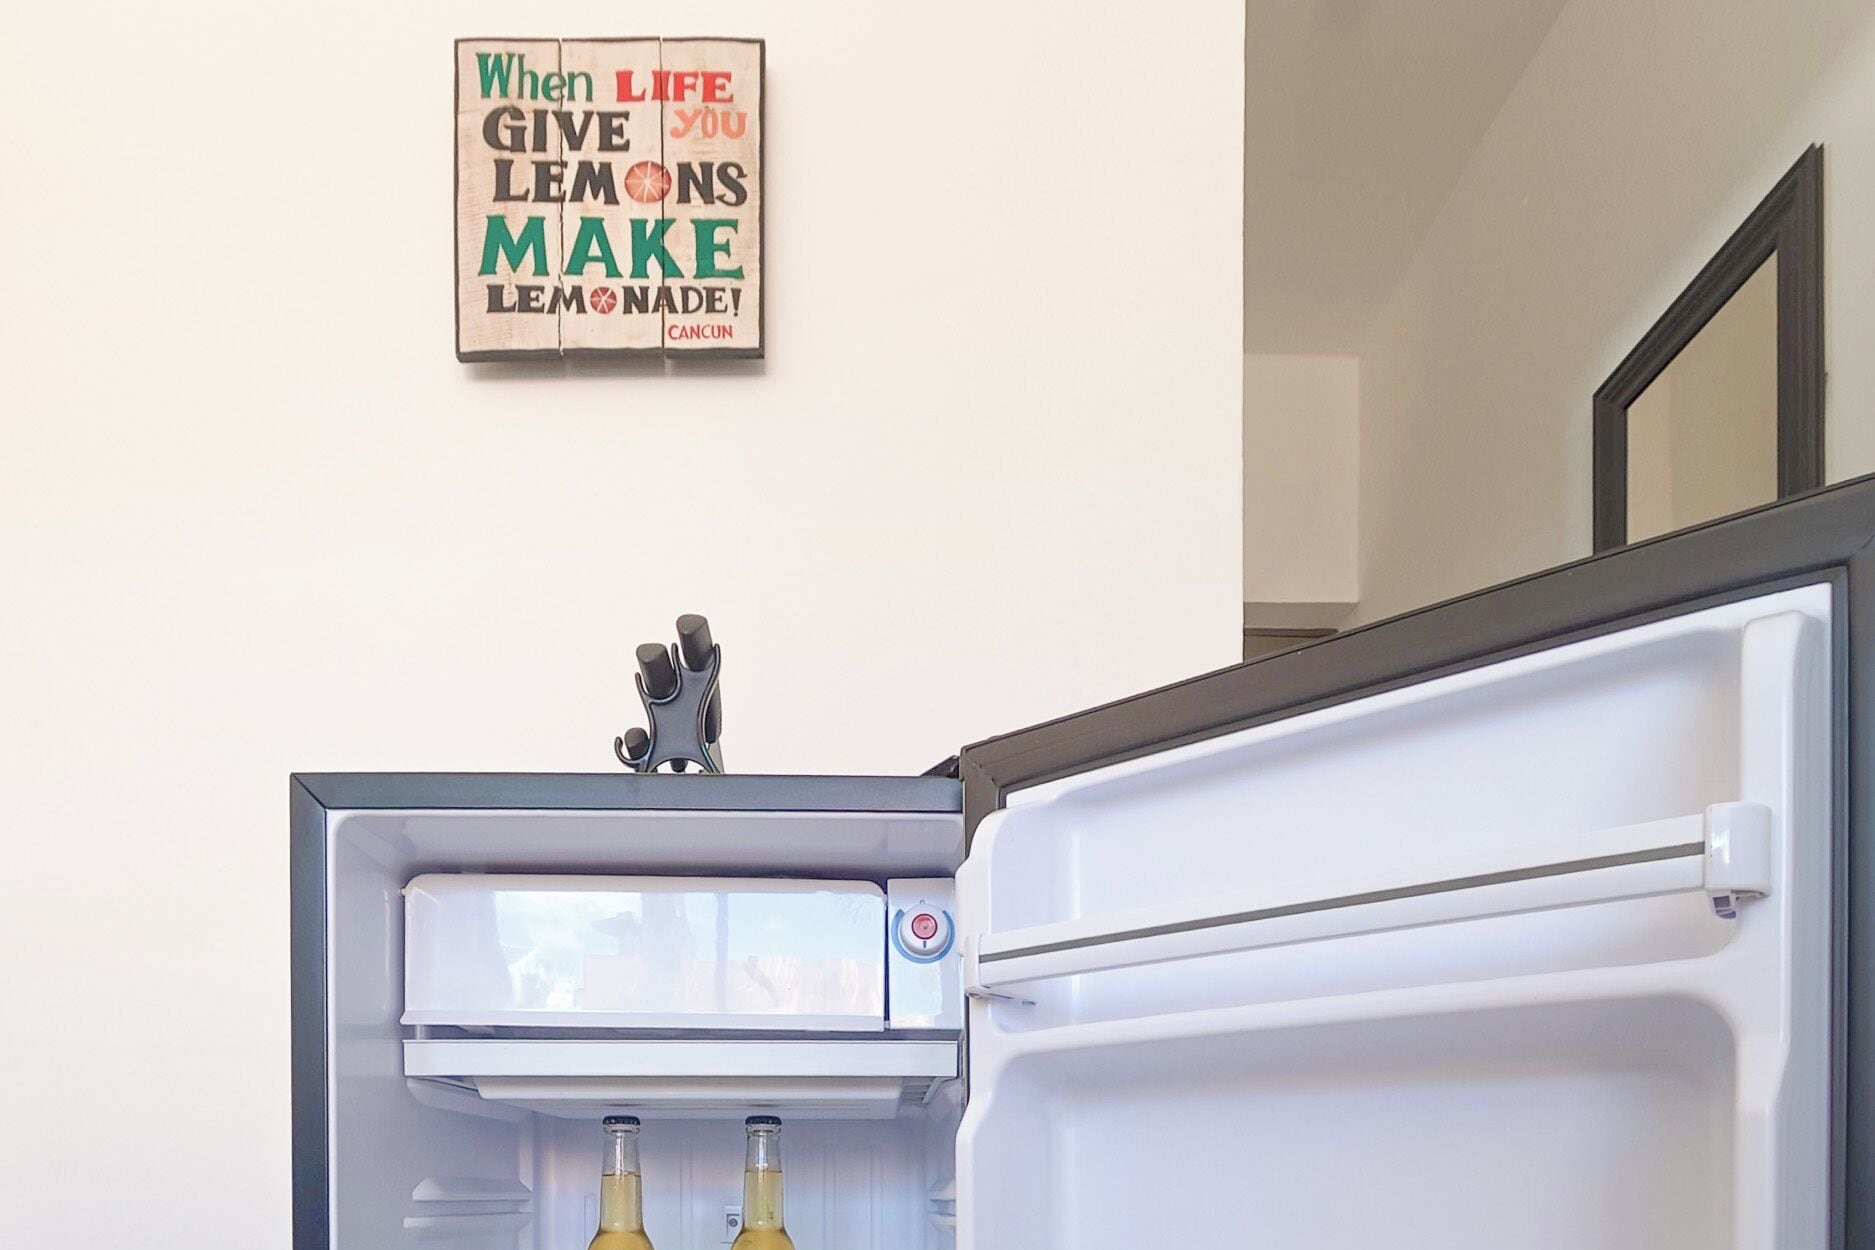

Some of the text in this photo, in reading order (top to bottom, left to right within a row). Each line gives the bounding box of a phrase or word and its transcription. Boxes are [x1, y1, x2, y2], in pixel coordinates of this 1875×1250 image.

[476, 53, 734, 103] When LIFE
[482, 105, 630, 153] GIVE
[478, 214, 744, 279] MAKE
[668, 324, 733, 340] CANCUN
